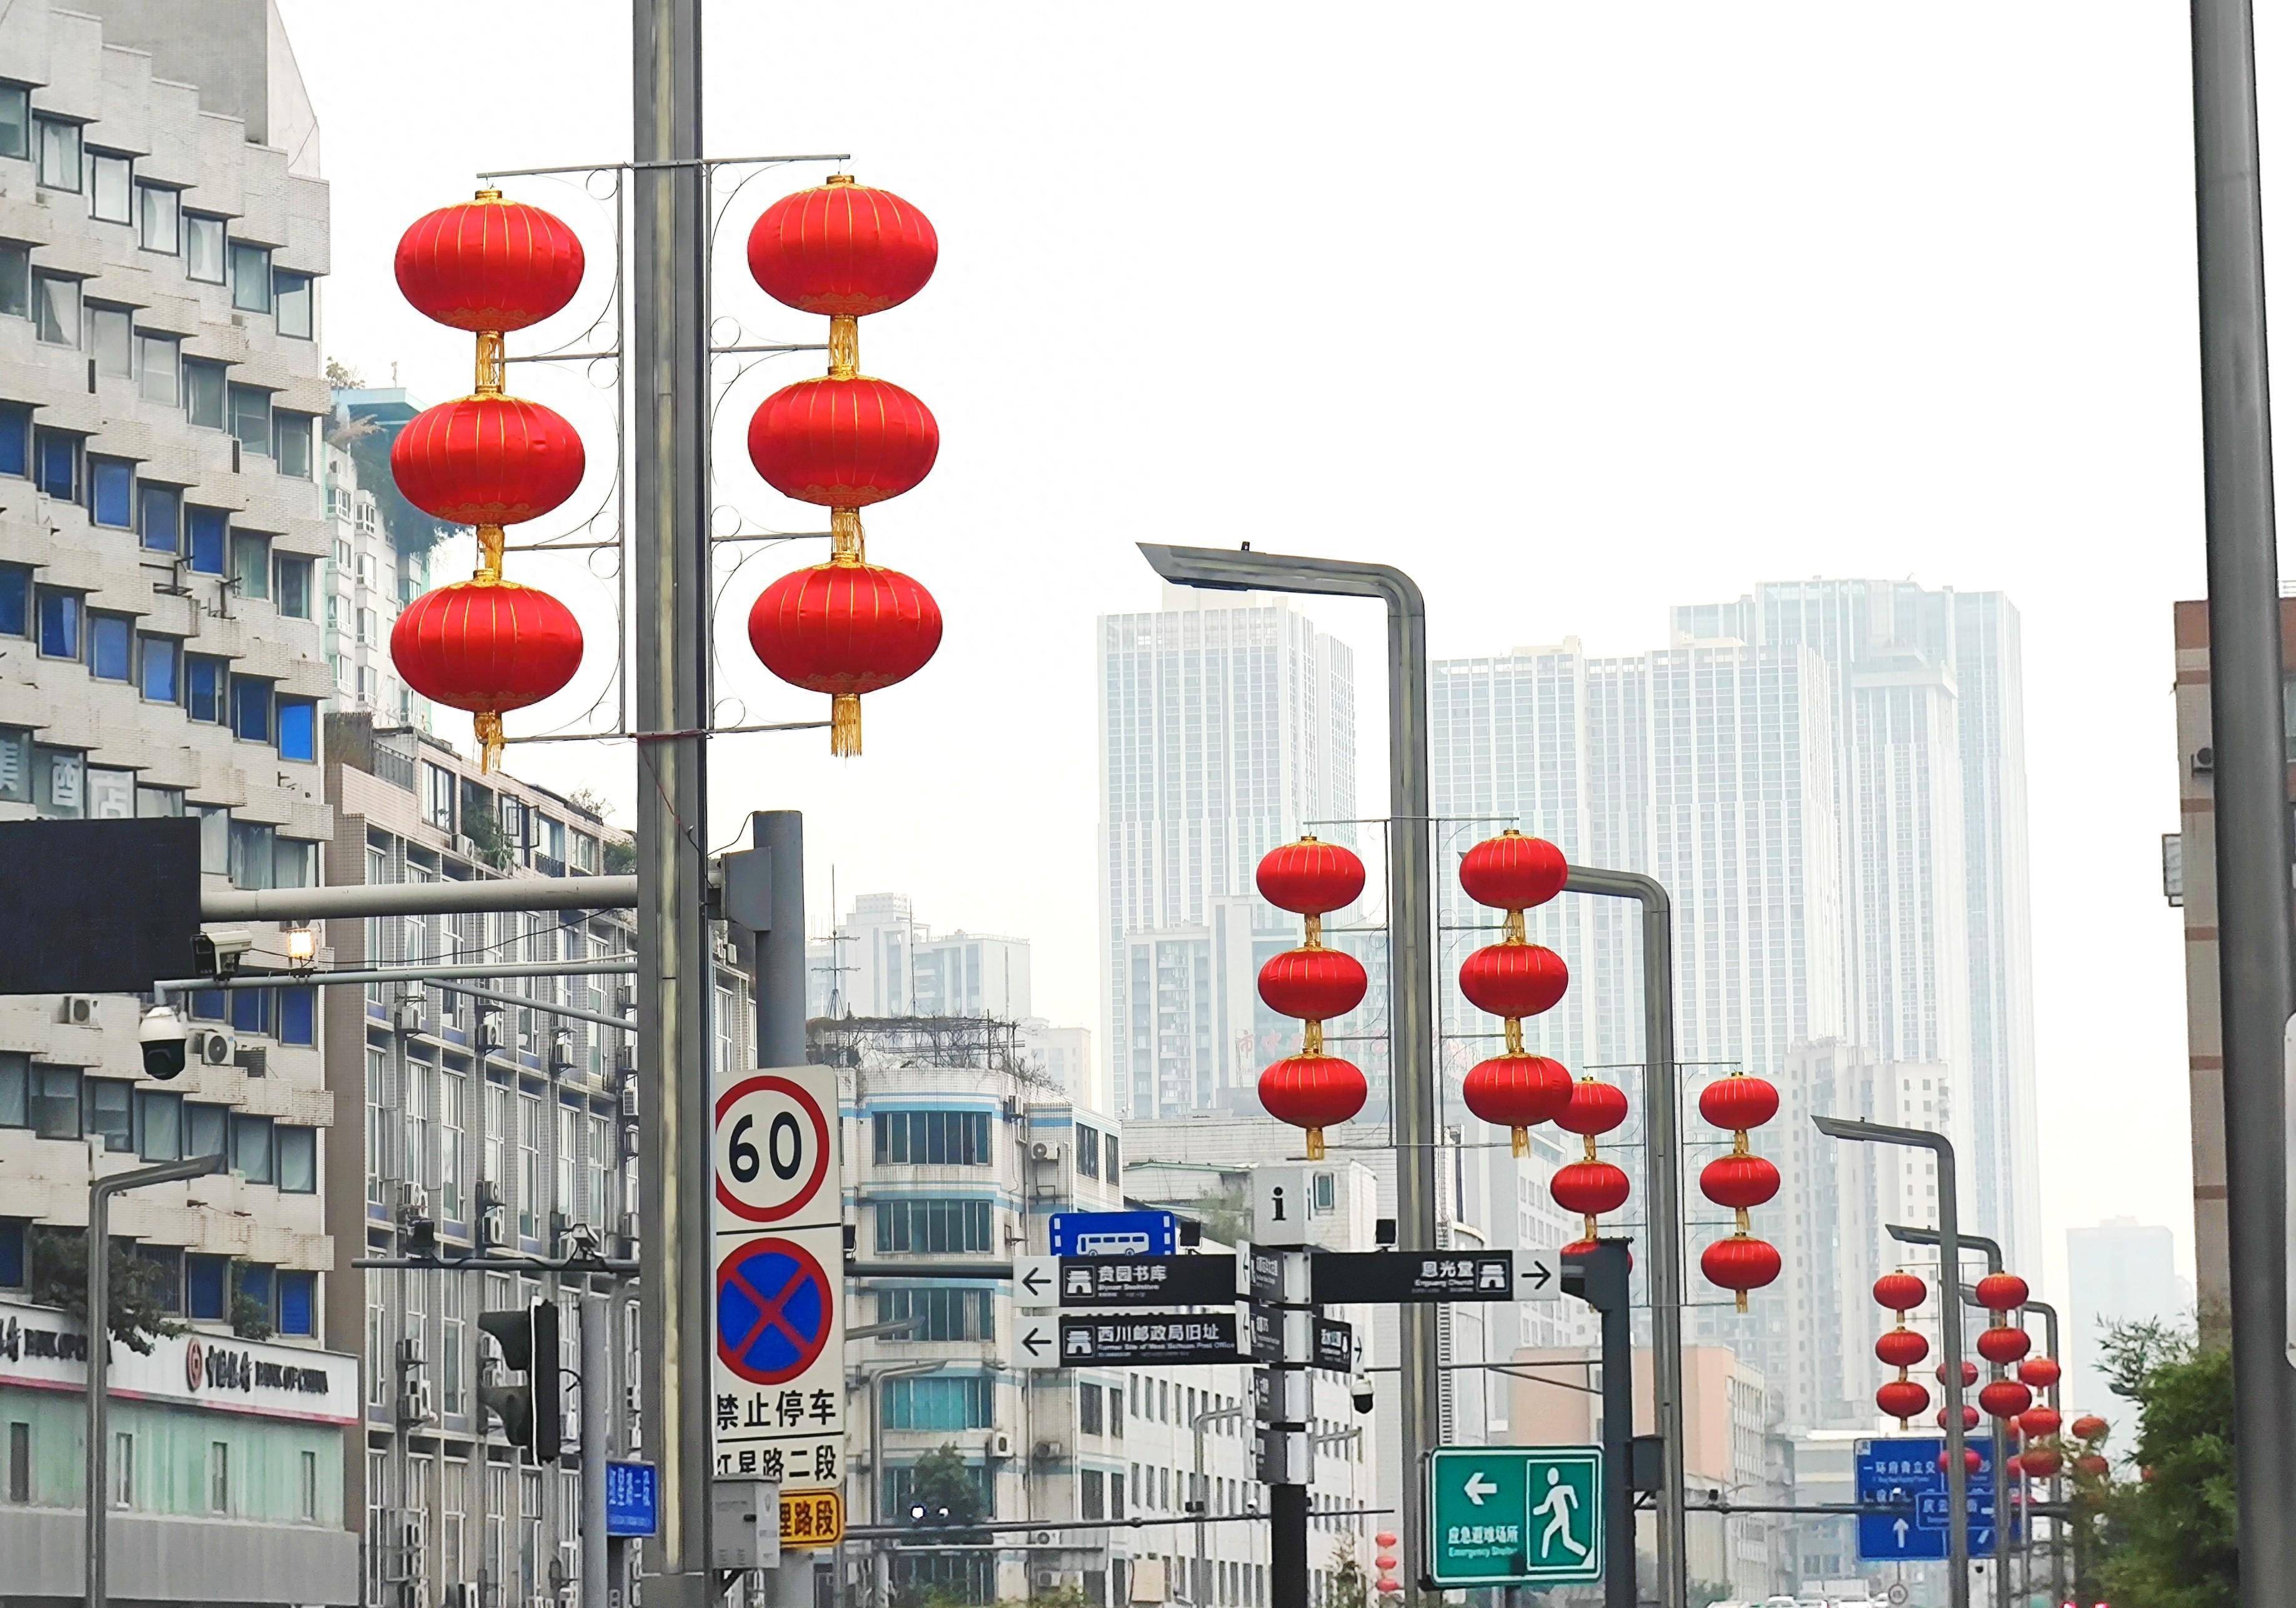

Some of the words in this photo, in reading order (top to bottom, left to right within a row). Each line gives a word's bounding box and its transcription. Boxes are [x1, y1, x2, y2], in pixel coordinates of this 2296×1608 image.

[729, 1111, 801, 1183] 60
[1422, 1260, 1474, 1278] 恩光堂
[1097, 1324, 1219, 1342] 西川邮政局旧址
[717, 1388, 836, 1431] 禁止停车
